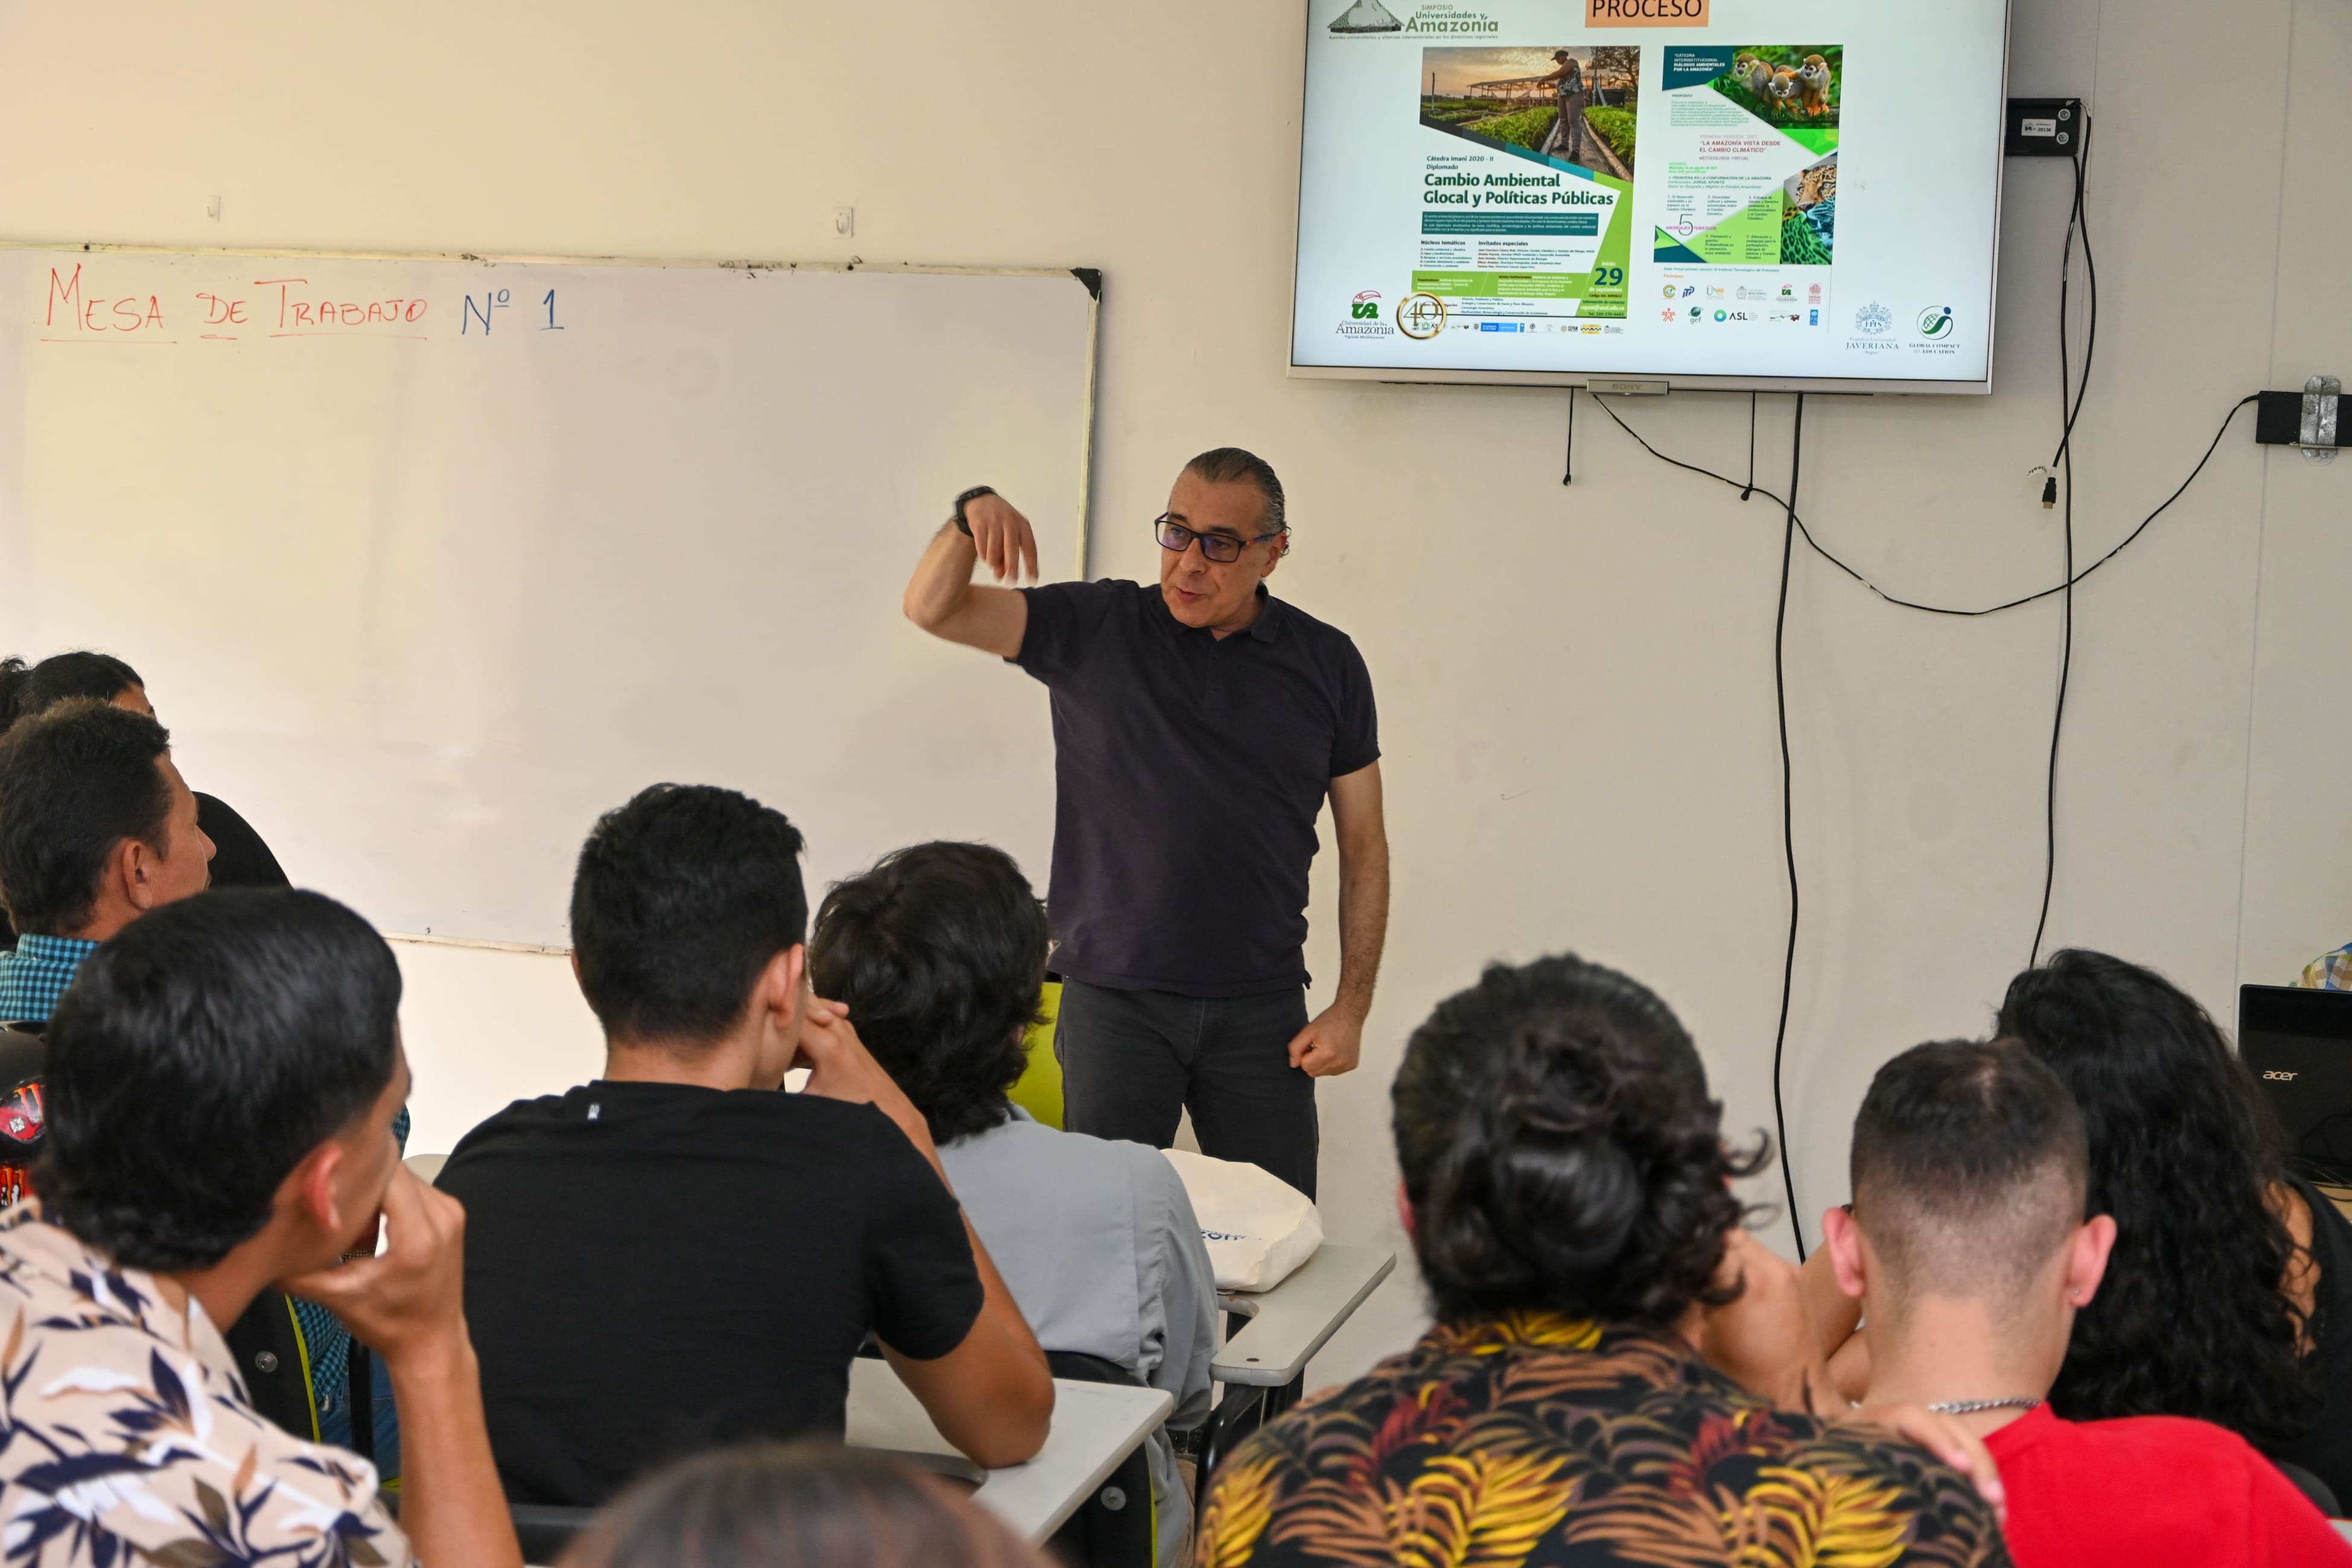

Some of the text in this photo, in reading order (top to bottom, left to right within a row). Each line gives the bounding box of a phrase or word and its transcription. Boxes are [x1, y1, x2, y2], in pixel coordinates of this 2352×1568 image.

[1592, 0, 1701, 17] PROCESO
[1405, 16, 1498, 32] Amazonía
[1424, 173, 1560, 186] Cambio Ambiental
[1424, 190, 1613, 208] Glocal y Políticas Públicas
[1678, 214, 1693, 235] 5
[1595, 267, 1623, 286] 29
[197, 293, 249, 324] DE
[253, 279, 428, 328] TRABAJO
[540, 289, 565, 331] 1
[1403, 301, 1438, 327] 40
[1729, 312, 1748, 320] ASL
[2263, 1071, 2298, 1081] acer
